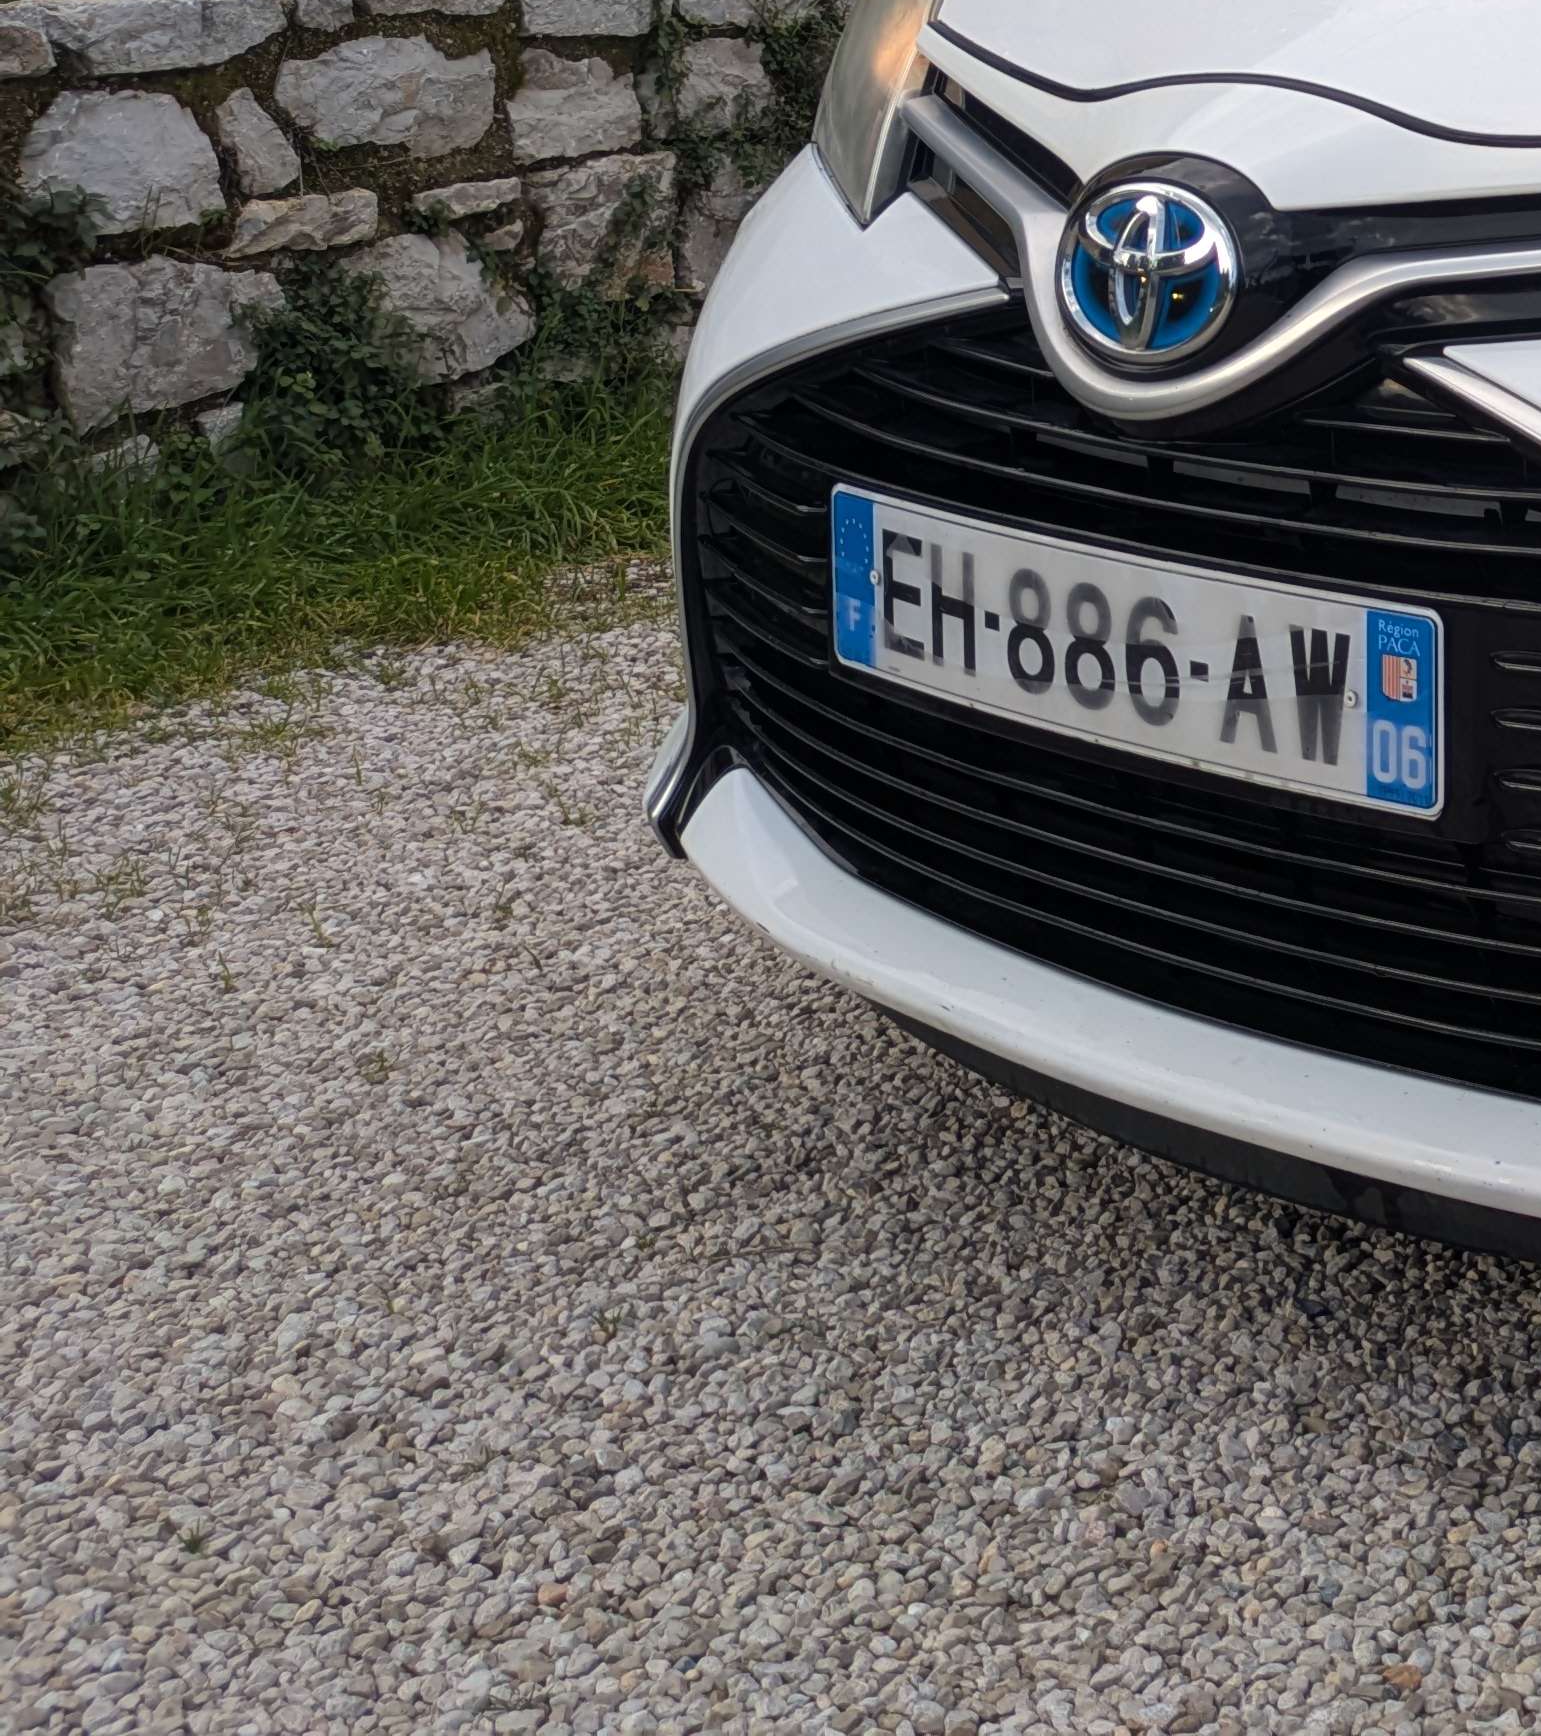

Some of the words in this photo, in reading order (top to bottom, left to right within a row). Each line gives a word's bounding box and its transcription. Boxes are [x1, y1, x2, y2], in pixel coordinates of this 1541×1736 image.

[848, 596, 862, 633] F
[1377, 618, 1420, 639] Région
[881, 528, 1351, 767] EH-886-AW
[1377, 634, 1421, 657] PACA
[1371, 718, 1428, 791] 06
